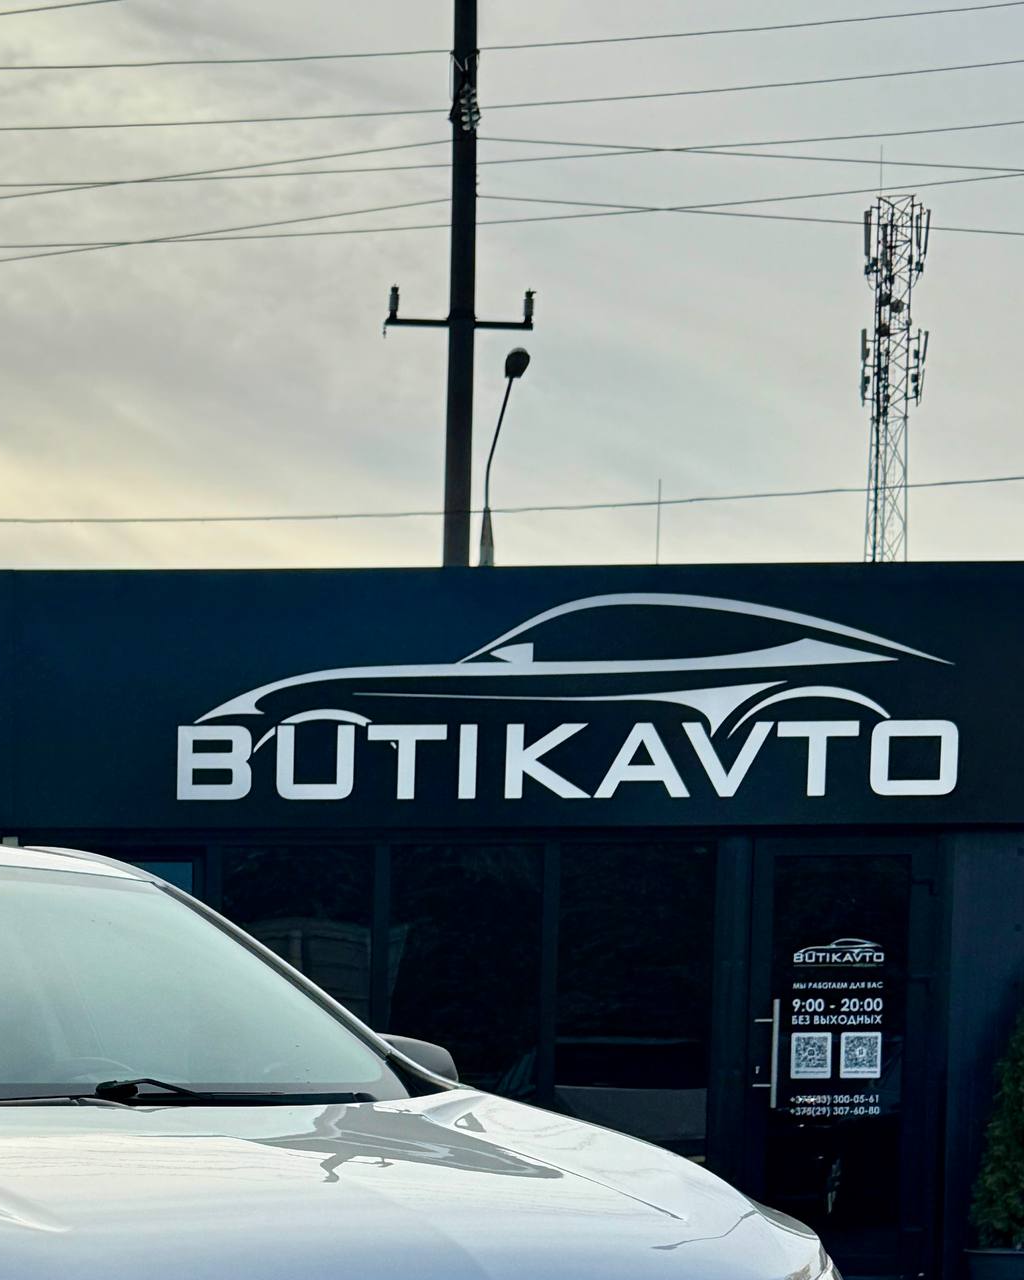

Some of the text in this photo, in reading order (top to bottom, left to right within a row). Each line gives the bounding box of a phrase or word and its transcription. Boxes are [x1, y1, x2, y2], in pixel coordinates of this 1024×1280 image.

[176, 719, 959, 801] BUTIKAVTO
[793, 951, 885, 963] BUTIKAVTO
[792, 982, 807, 990] МЫ
[808, 981, 848, 990] РАБОТАЕМ
[867, 981, 884, 989] ВАС
[792, 998, 825, 1012] 9:00
[840, 998, 884, 1012] 20:00
[791, 1014, 883, 1025] БЕЗ ВЫХОДНЫХ
